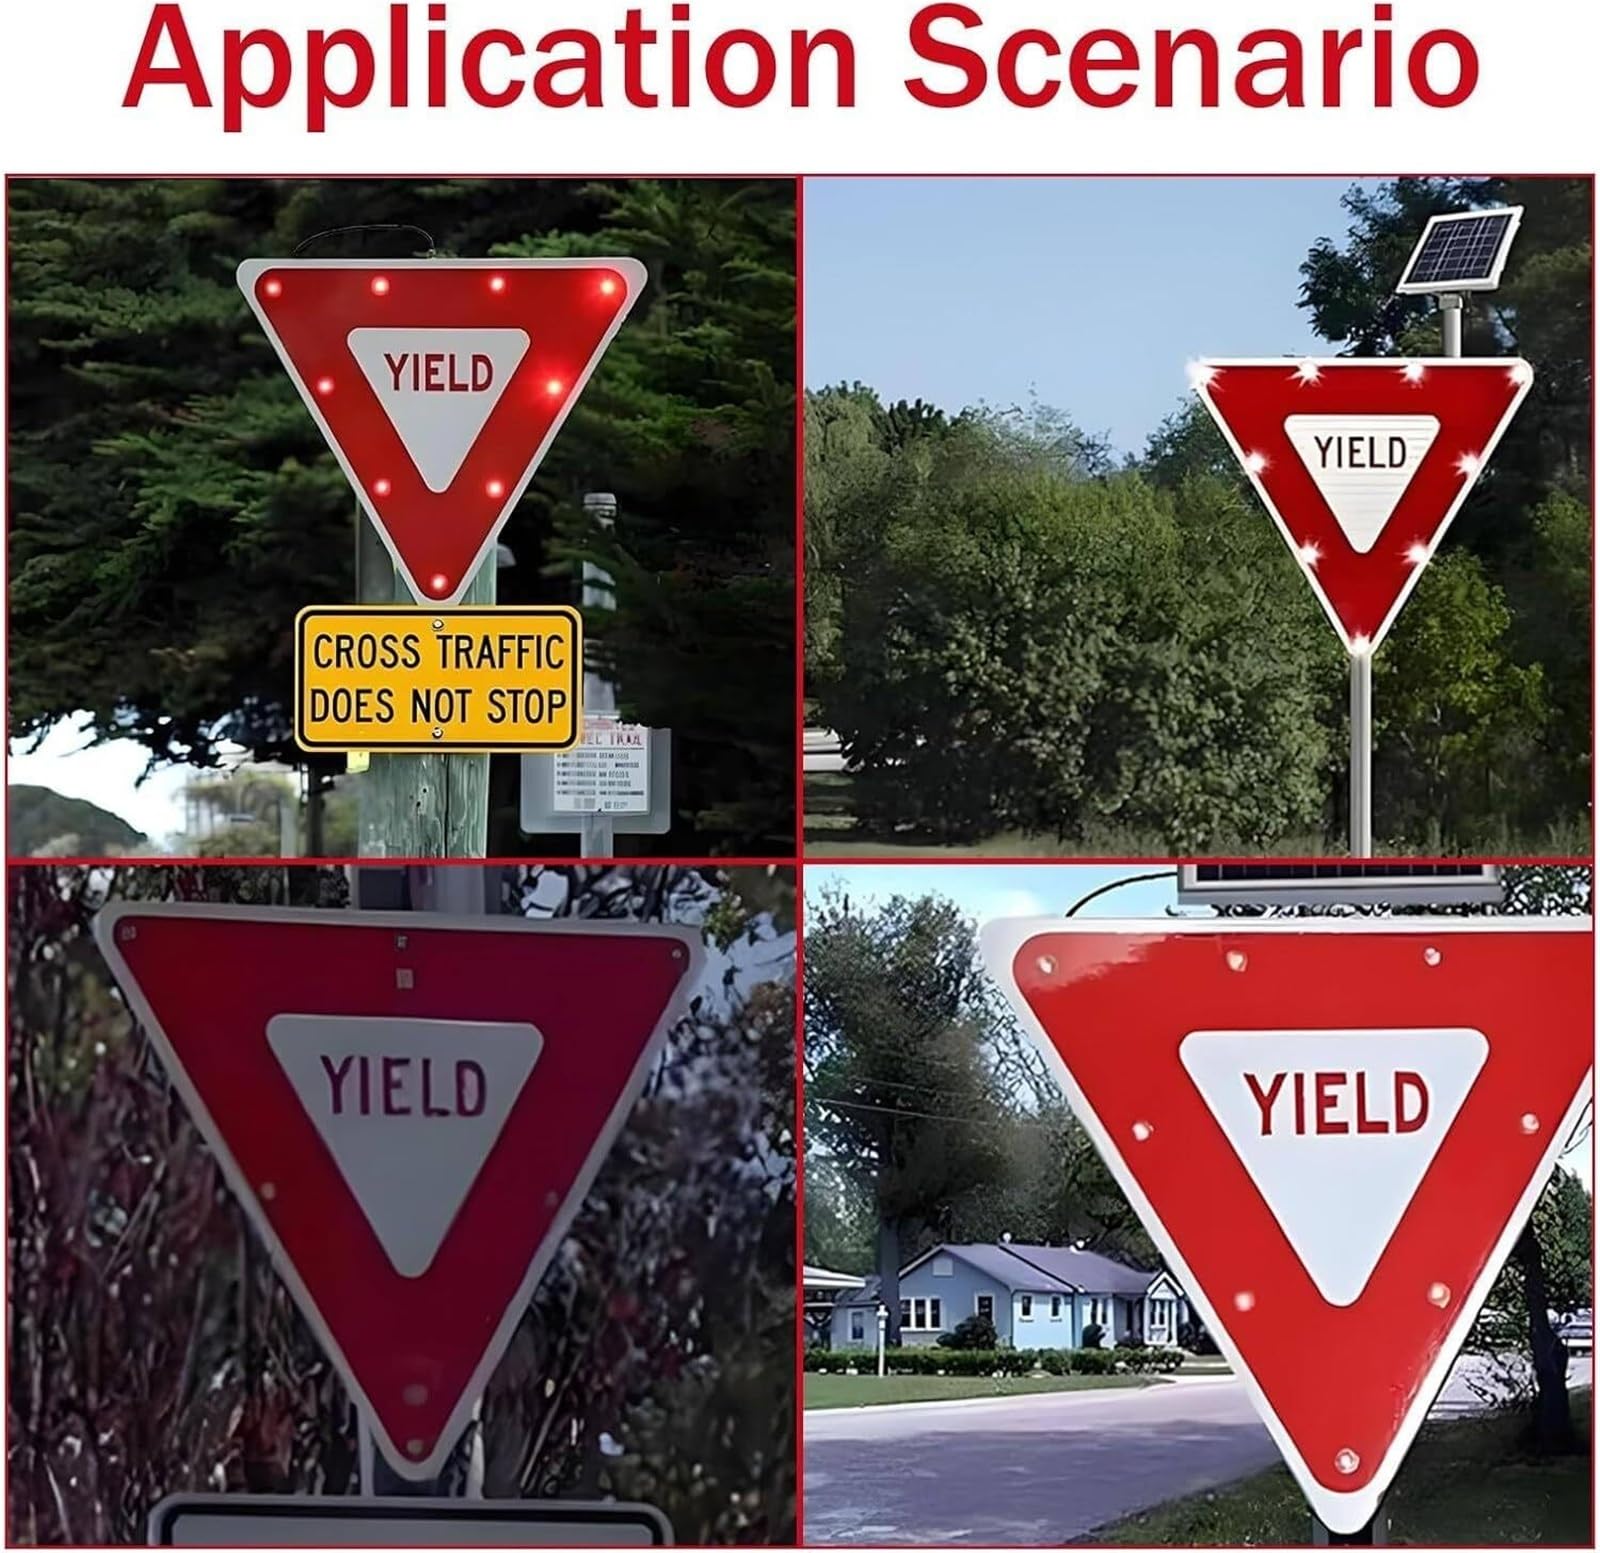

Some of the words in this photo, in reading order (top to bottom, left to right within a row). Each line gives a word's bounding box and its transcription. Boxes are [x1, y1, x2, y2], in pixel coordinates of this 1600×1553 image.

[383, 353, 494, 393] YIELD
[1313, 435, 1407, 470] YIELD
[314, 633, 421, 669] CROSS
[436, 634, 564, 670] TRAFFIC
[310, 687, 394, 723] DOES
[412, 688, 473, 724] NOT
[487, 688, 567, 724] STOP
[319, 1054, 487, 1118] YIELD
[1243, 1071, 1430, 1136] YIELD
